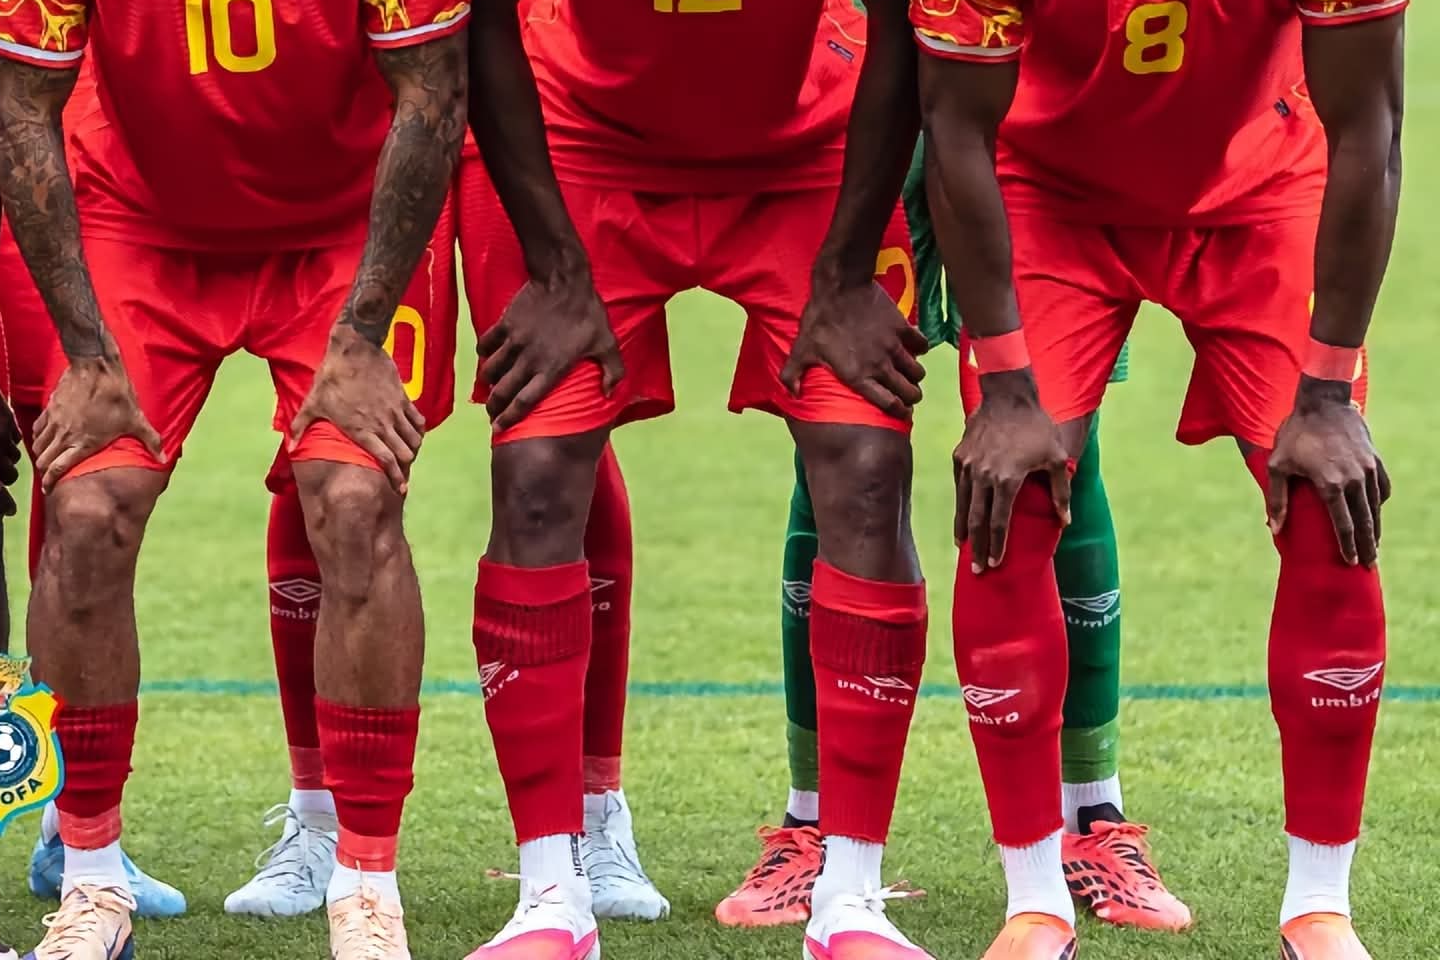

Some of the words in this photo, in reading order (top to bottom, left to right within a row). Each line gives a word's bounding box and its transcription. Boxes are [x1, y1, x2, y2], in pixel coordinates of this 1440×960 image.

[1123, 1, 1188, 74] 8
[381, 305, 425, 402] 0
[969, 711, 1019, 725] mbro
